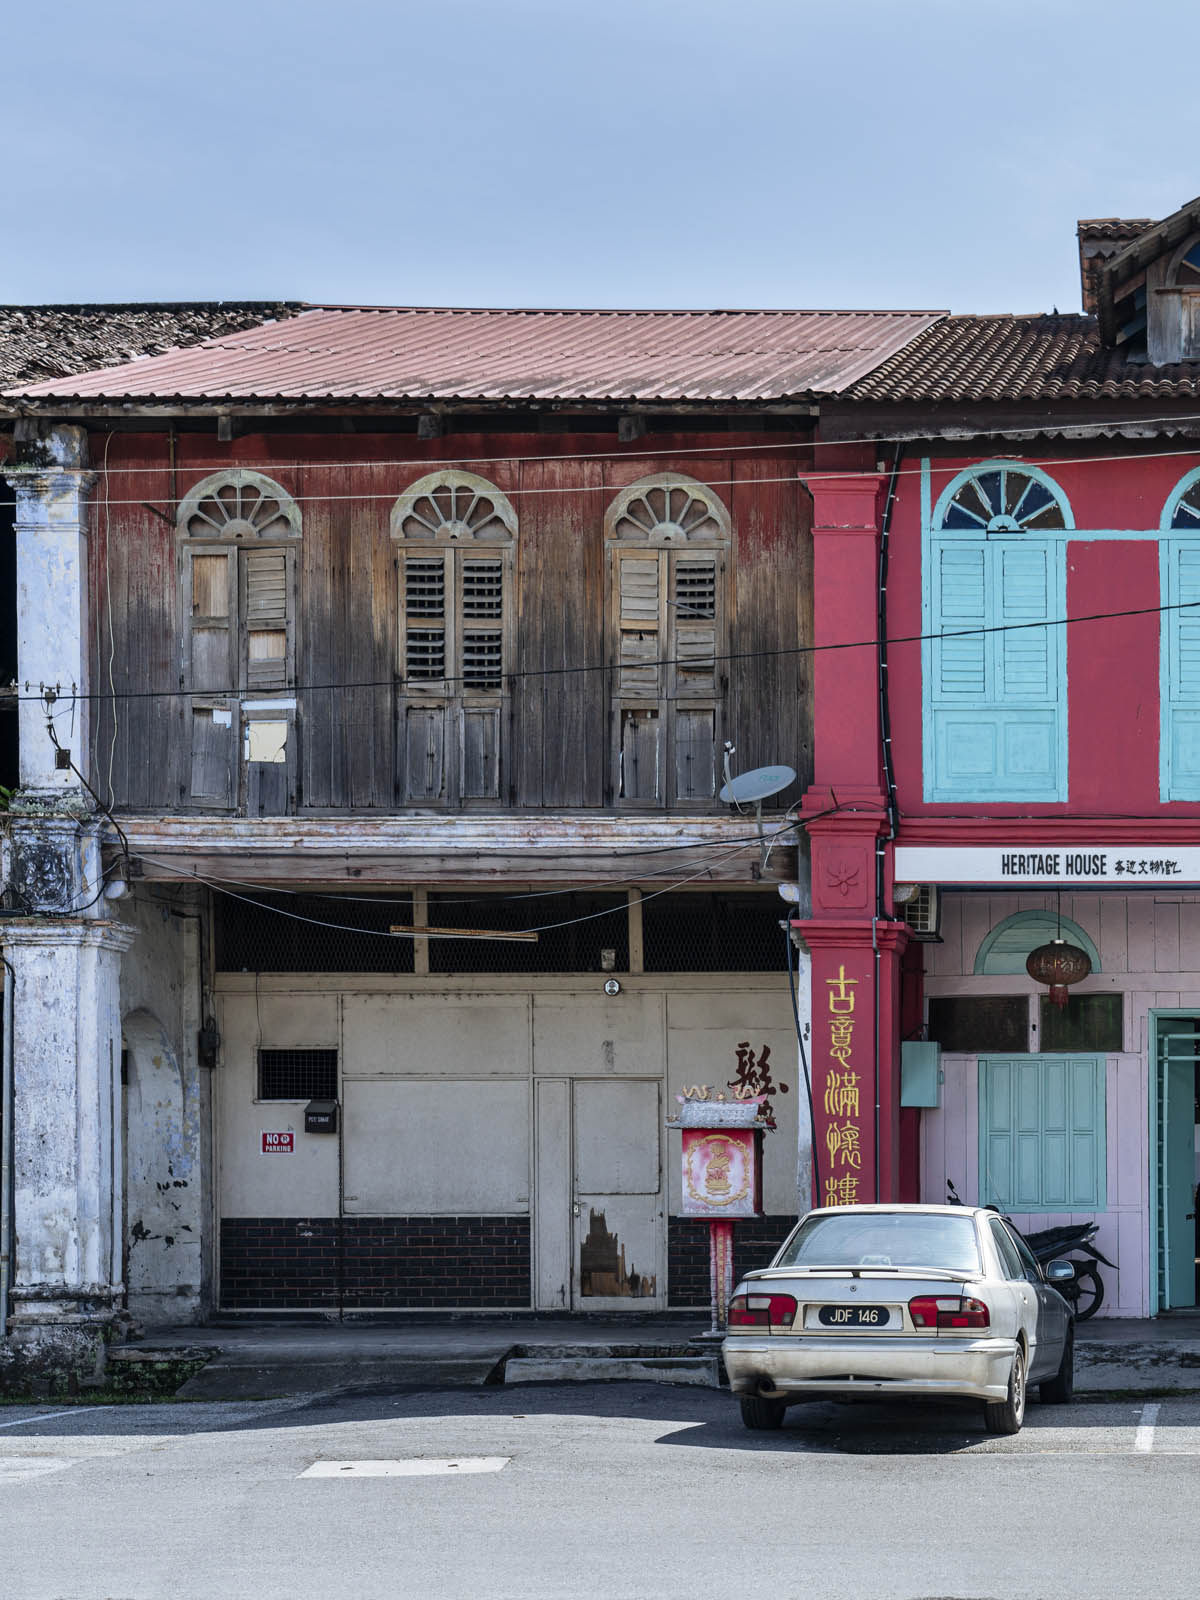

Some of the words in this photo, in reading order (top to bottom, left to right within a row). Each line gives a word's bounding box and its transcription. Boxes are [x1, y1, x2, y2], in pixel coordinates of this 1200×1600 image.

[1065, 854, 1107, 876] HOUSE
[266, 1134, 279, 1145] NO
[829, 1308, 853, 1323] JDF
[858, 1309, 879, 1323] 146
